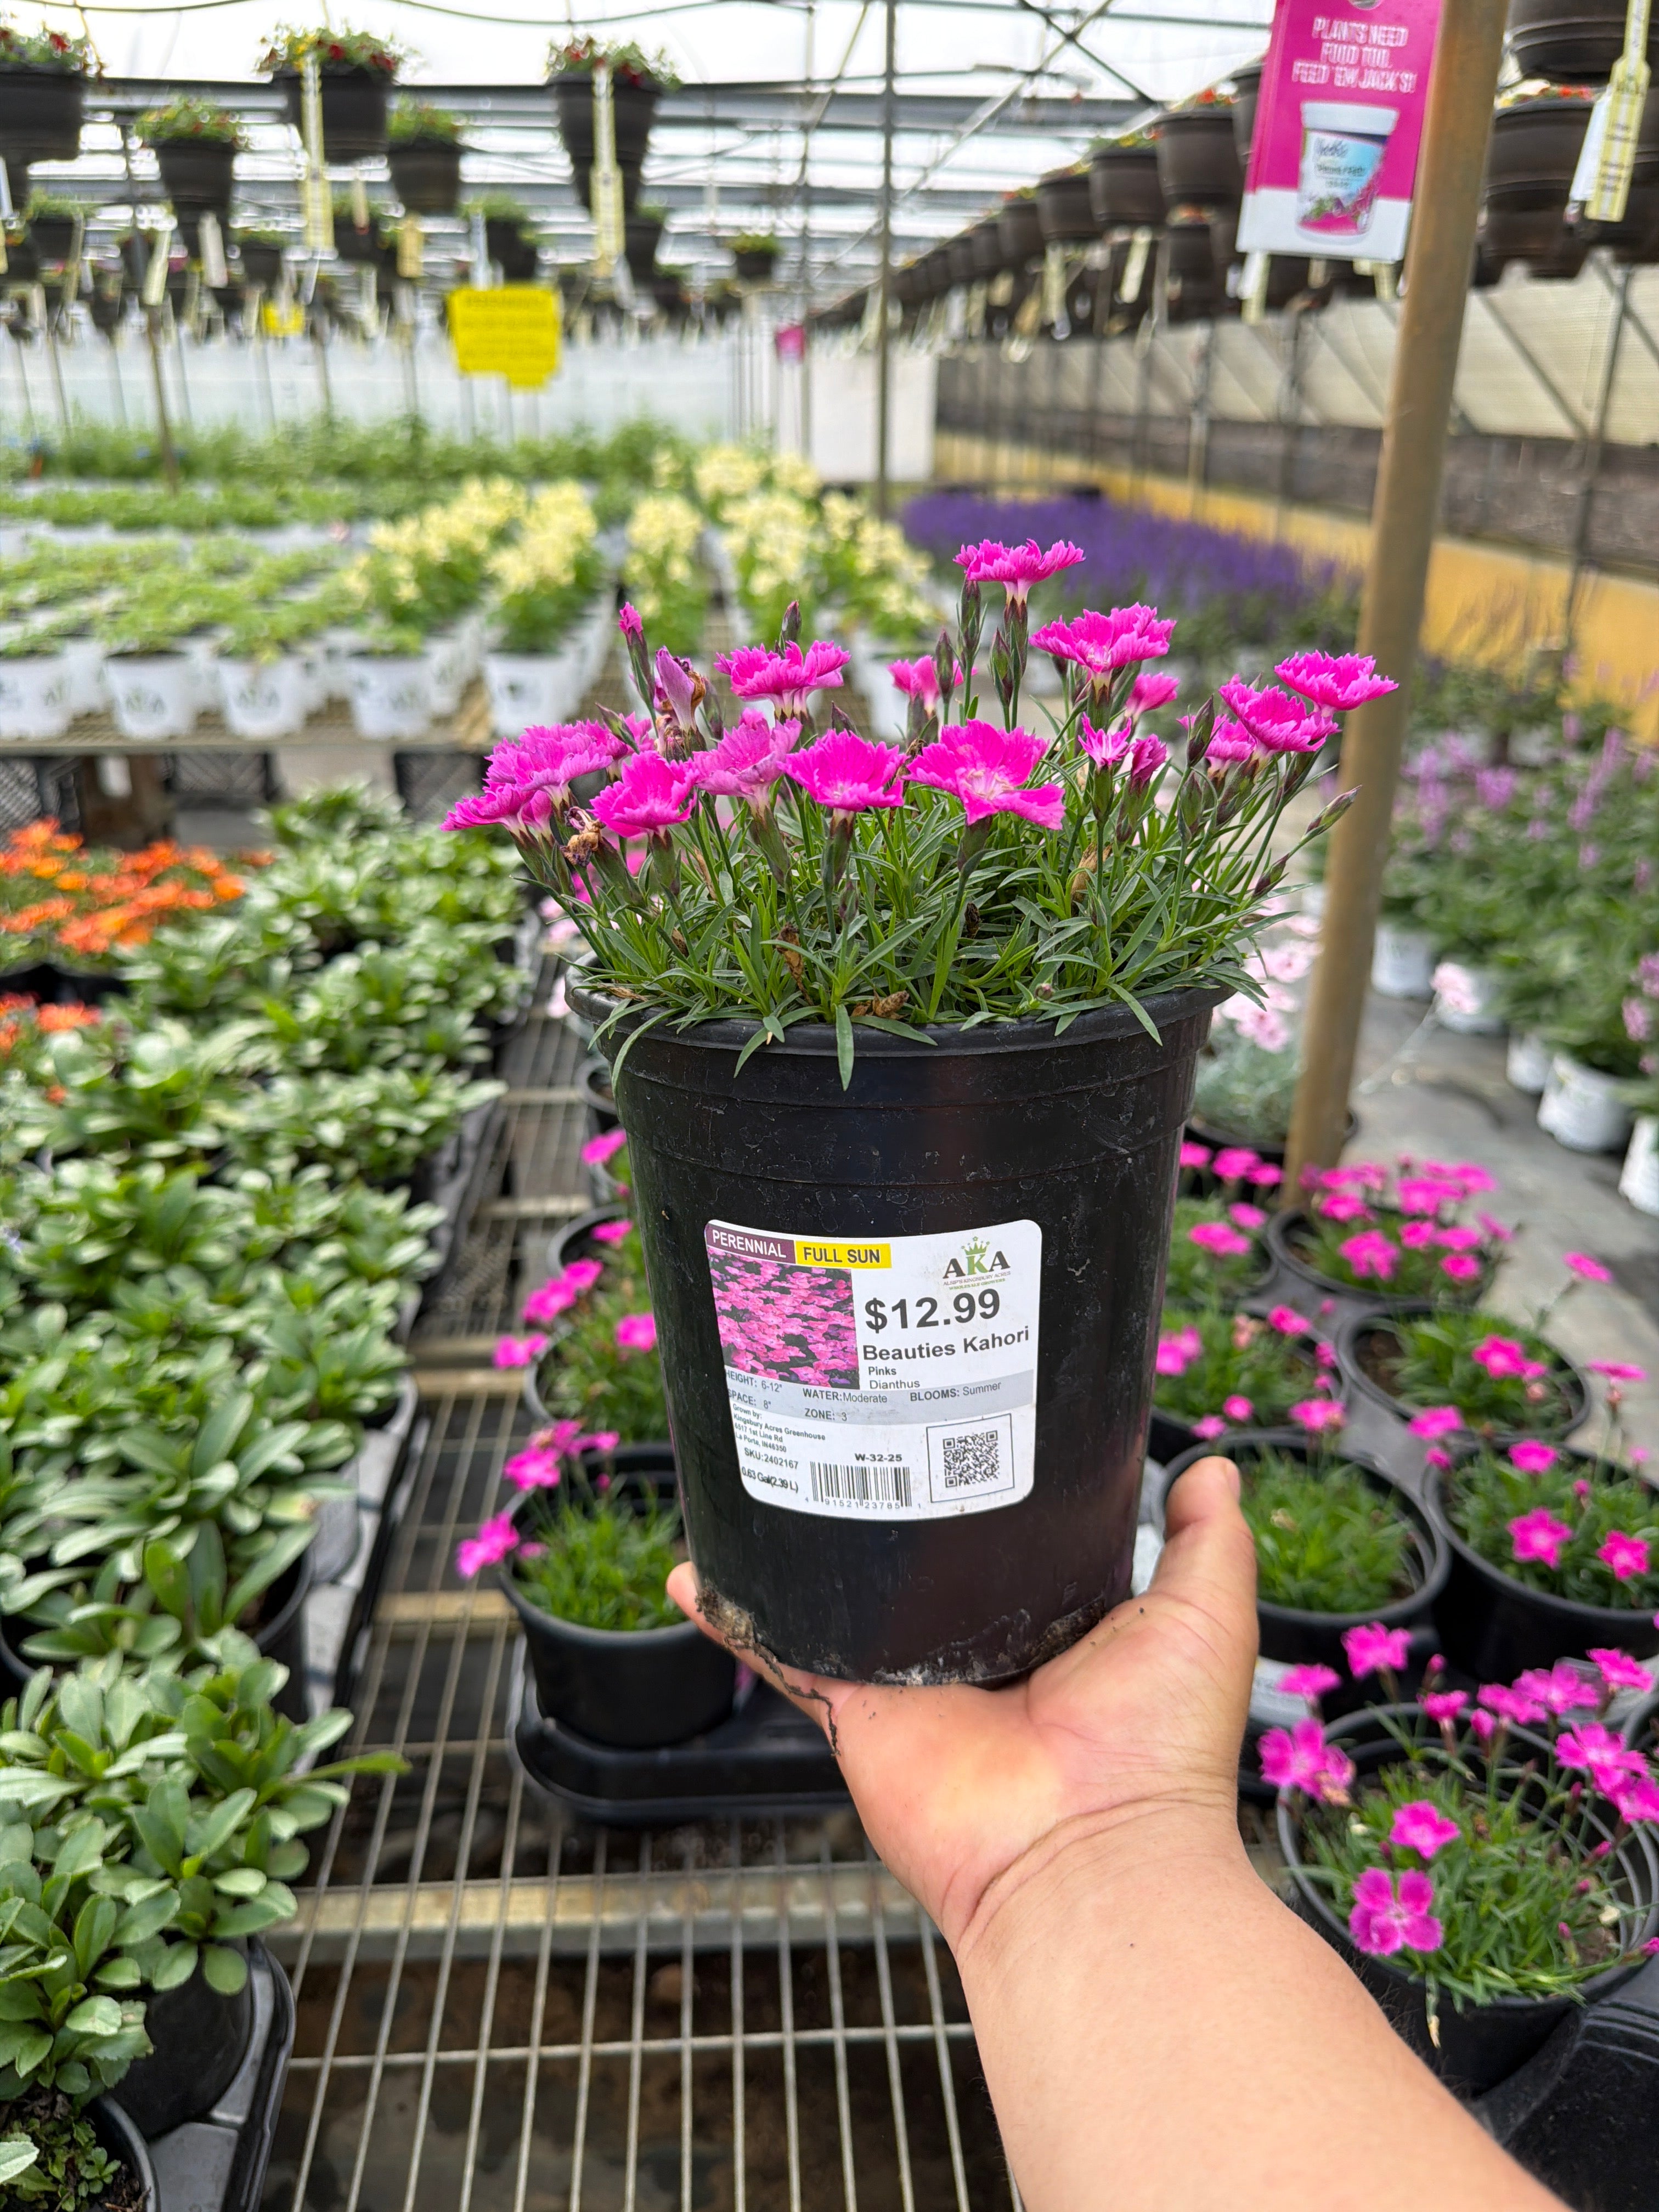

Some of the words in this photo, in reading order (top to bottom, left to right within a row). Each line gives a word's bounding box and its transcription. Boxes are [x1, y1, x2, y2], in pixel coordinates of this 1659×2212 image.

[1369, 25, 1408, 47] NEED
[1321, 42, 1359, 65] FOOD
[1292, 61, 1330, 84] FEED
[713, 1230, 786, 1258] PERENNIAL
[804, 1247, 842, 1262] FULL
[847, 1249, 880, 1263] SUN
[943, 1251, 1011, 1279] AKA
[865, 1288, 1000, 1334] $12.99
[863, 1342, 956, 1360] Beauties
[963, 1325, 1029, 1353] Kahori
[868, 1366, 896, 1375] Pinks
[761, 1380, 782, 1392] 6-12"
[870, 1379, 920, 1389] Dianthus
[910, 1388, 960, 1402] BLOOMS:
[962, 1381, 1002, 1396] Summer
[733, 1403, 751, 1415] Grown
[752, 1410, 762, 1419] by:
[763, 1400, 771, 1409] 8"
[804, 1408, 835, 1420] ZONE:
[841, 1412, 848, 1421] 3
[733, 1413, 763, 1429] Kingsbury
[765, 1423, 782, 1433] Acres
[784, 1427, 826, 1440] Greenhouse
[735, 1423, 747, 1432] 6517
[749, 1427, 758, 1436] 1st
[759, 1430, 772, 1440] Line
[735, 1431, 742, 1440] La
[743, 1434, 761, 1447] Porte,
[855, 1453, 902, 1462] W-32-25
